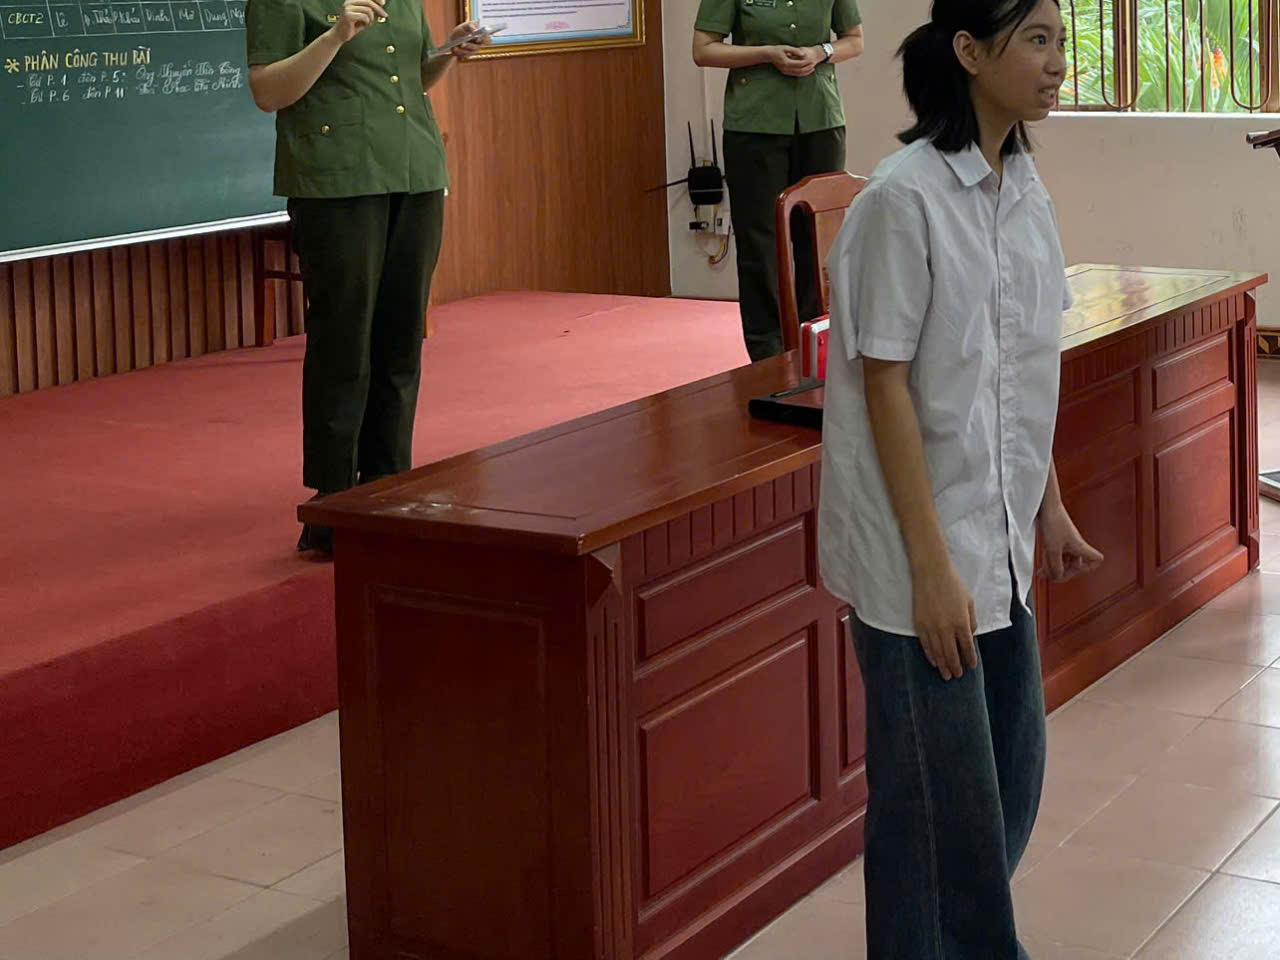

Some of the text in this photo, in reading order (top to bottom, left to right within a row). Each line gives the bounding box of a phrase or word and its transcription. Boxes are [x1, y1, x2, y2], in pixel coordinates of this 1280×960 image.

[25, 46, 151, 72] PHÂN CÔNG THU BÀI
